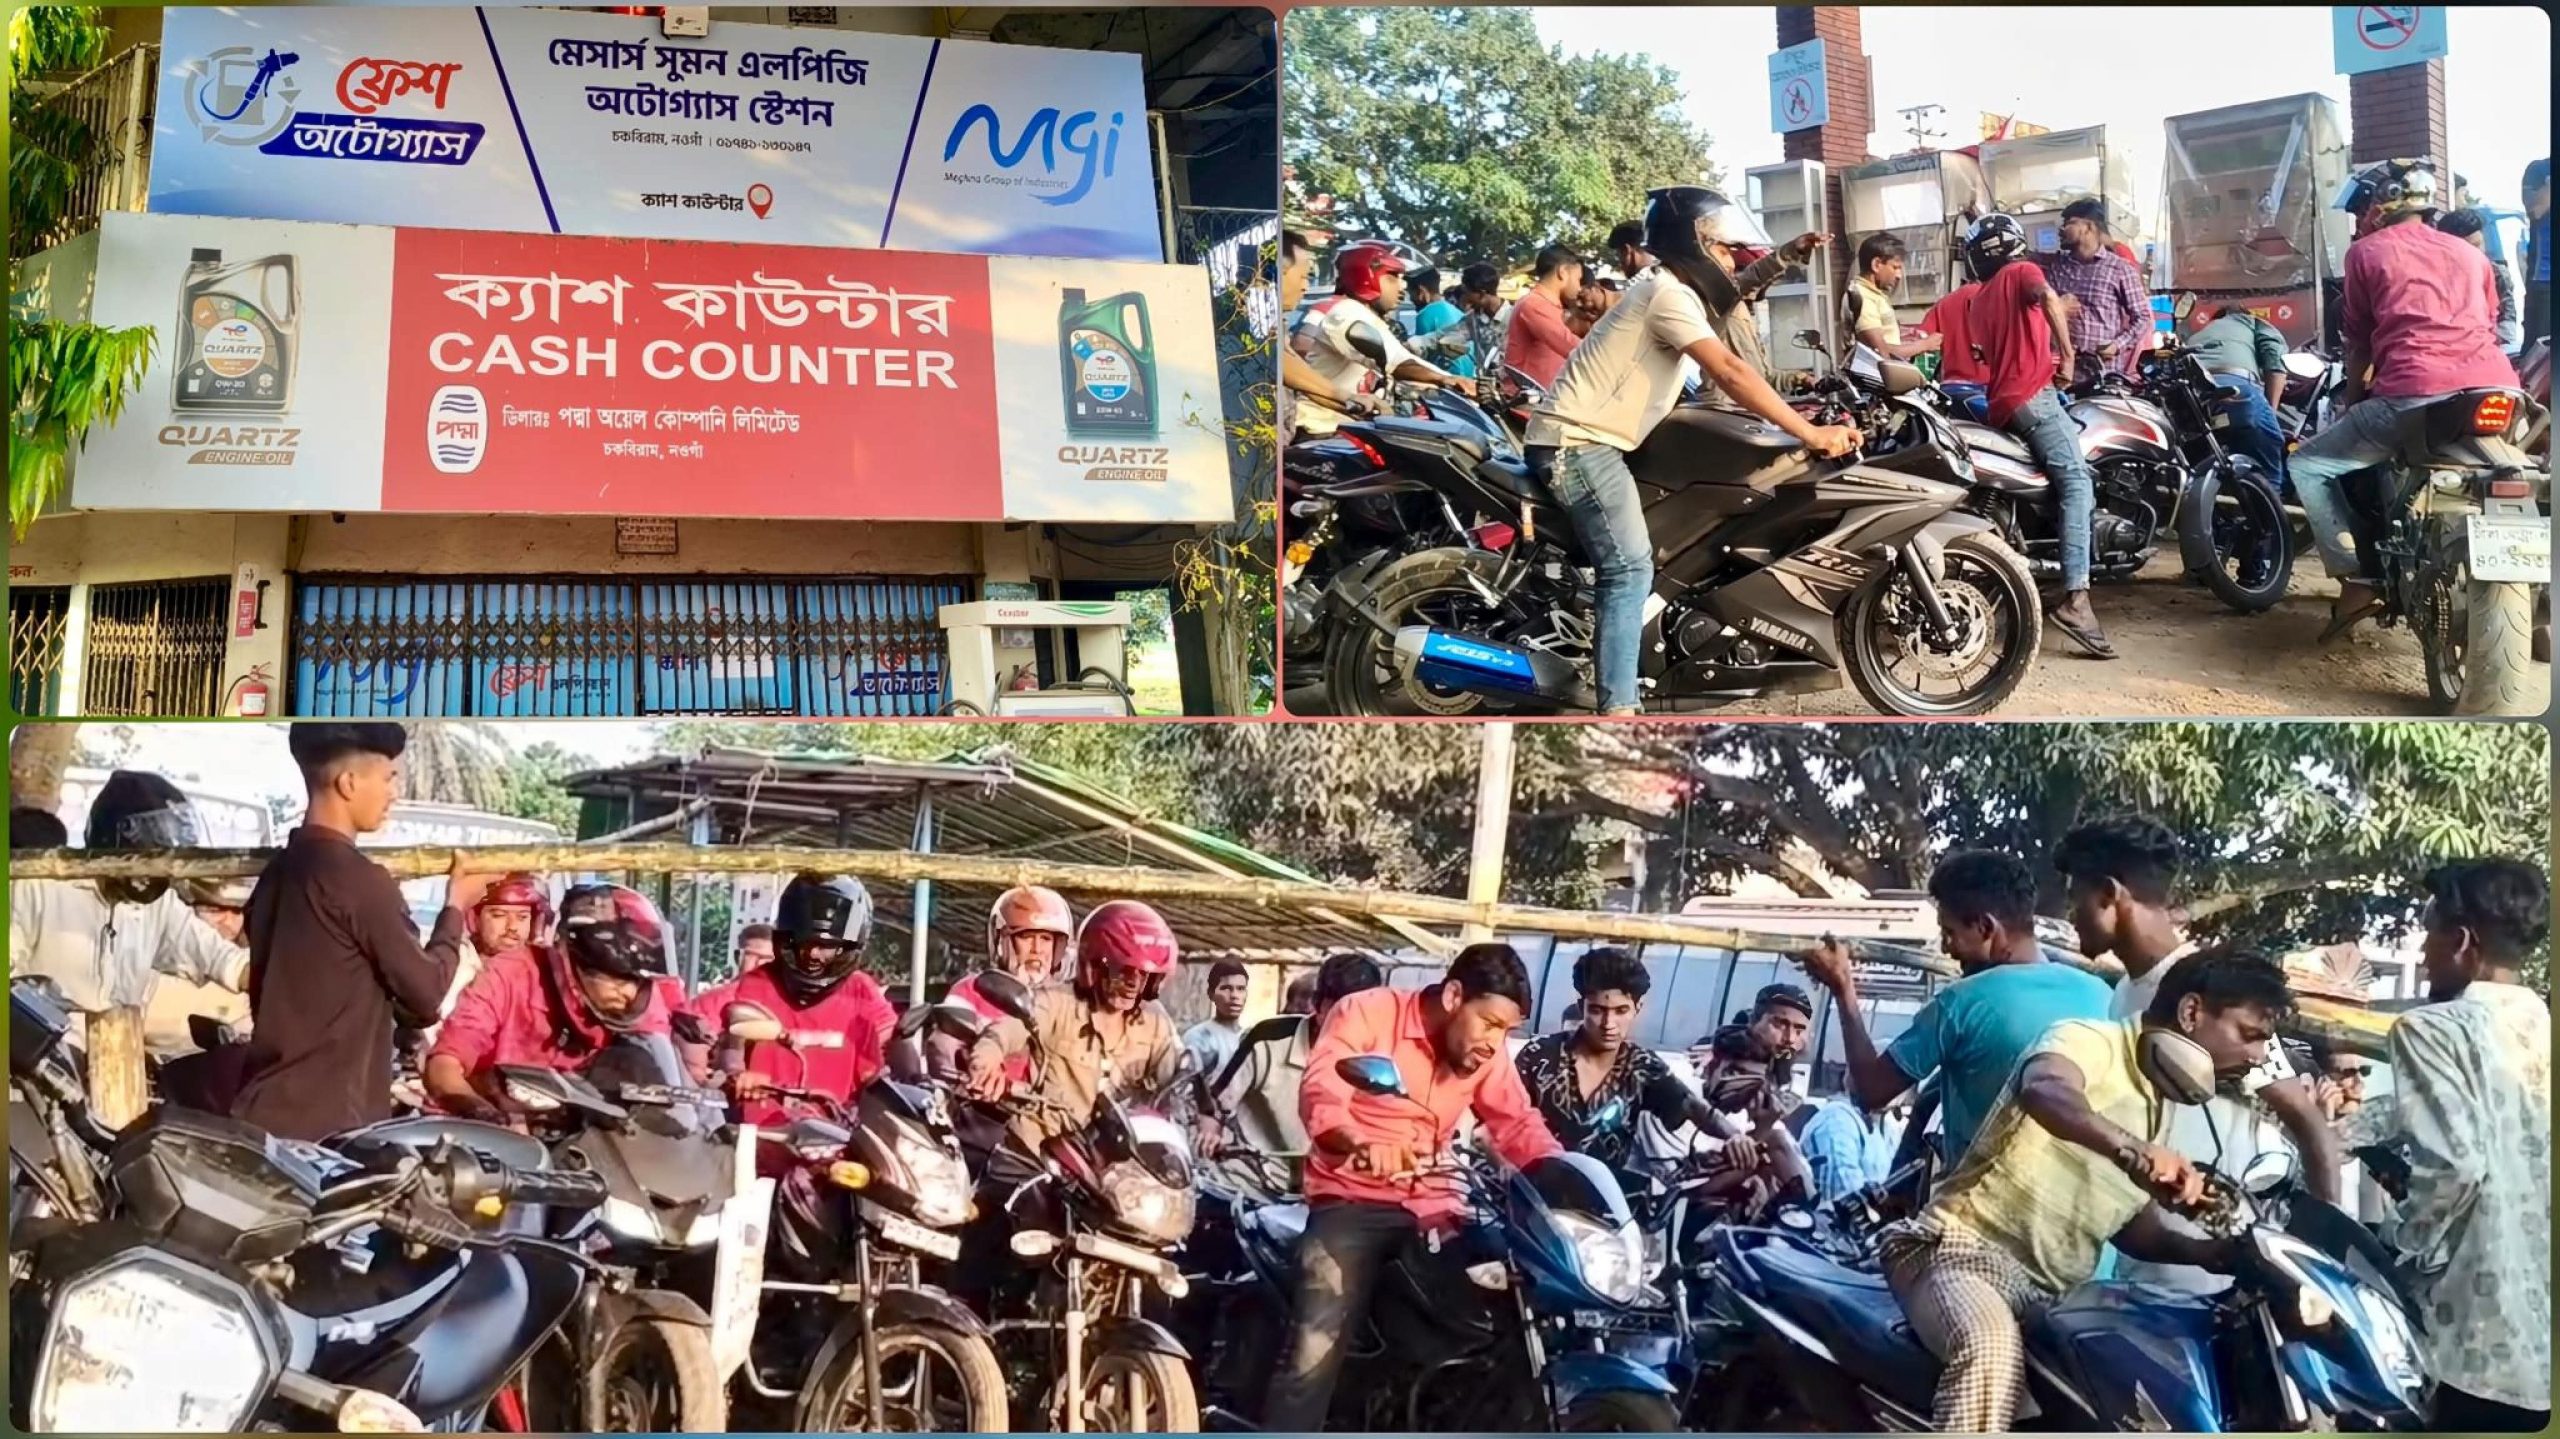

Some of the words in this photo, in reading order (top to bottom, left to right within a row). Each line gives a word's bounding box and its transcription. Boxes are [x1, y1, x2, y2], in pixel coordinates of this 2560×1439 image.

[549, 38, 649, 70] মেসার্স
[655, 46, 728, 81] সুমন
[737, 49, 869, 85] এলপিজি
[336, 57, 462, 114] ফ্রেশ
[585, 82, 738, 121] অটোগ্যাস
[749, 90, 834, 127] স্টেশন
[294, 119, 469, 160] অটোগ্যাস
[641, 193, 678, 209] ক্যাশ
[433, 272, 634, 325] ক্যাশ
[653, 271, 957, 338] কাউন্টার
[429, 332, 617, 378] CASH
[642, 341, 959, 389] COUNTER
[435, 421, 479, 440] পদ্মা
[502, 404, 550, 430] ডিলারঃ
[558, 406, 591, 430] পদ্মা
[597, 408, 647, 431] অয়েল
[653, 407, 726, 433] কোম্পানি
[732, 407, 800, 434] লিমিটেড
[158, 425, 301, 447] QUARTZ
[205, 451, 261, 464] ENGINE
[265, 452, 291, 464] OIL
[1058, 446, 1169, 465] QUARTZ
[1098, 469, 1141, 480] ENGINE
[1144, 470, 1165, 480] OIL
[1750, 617, 1807, 649] YAMAHA
